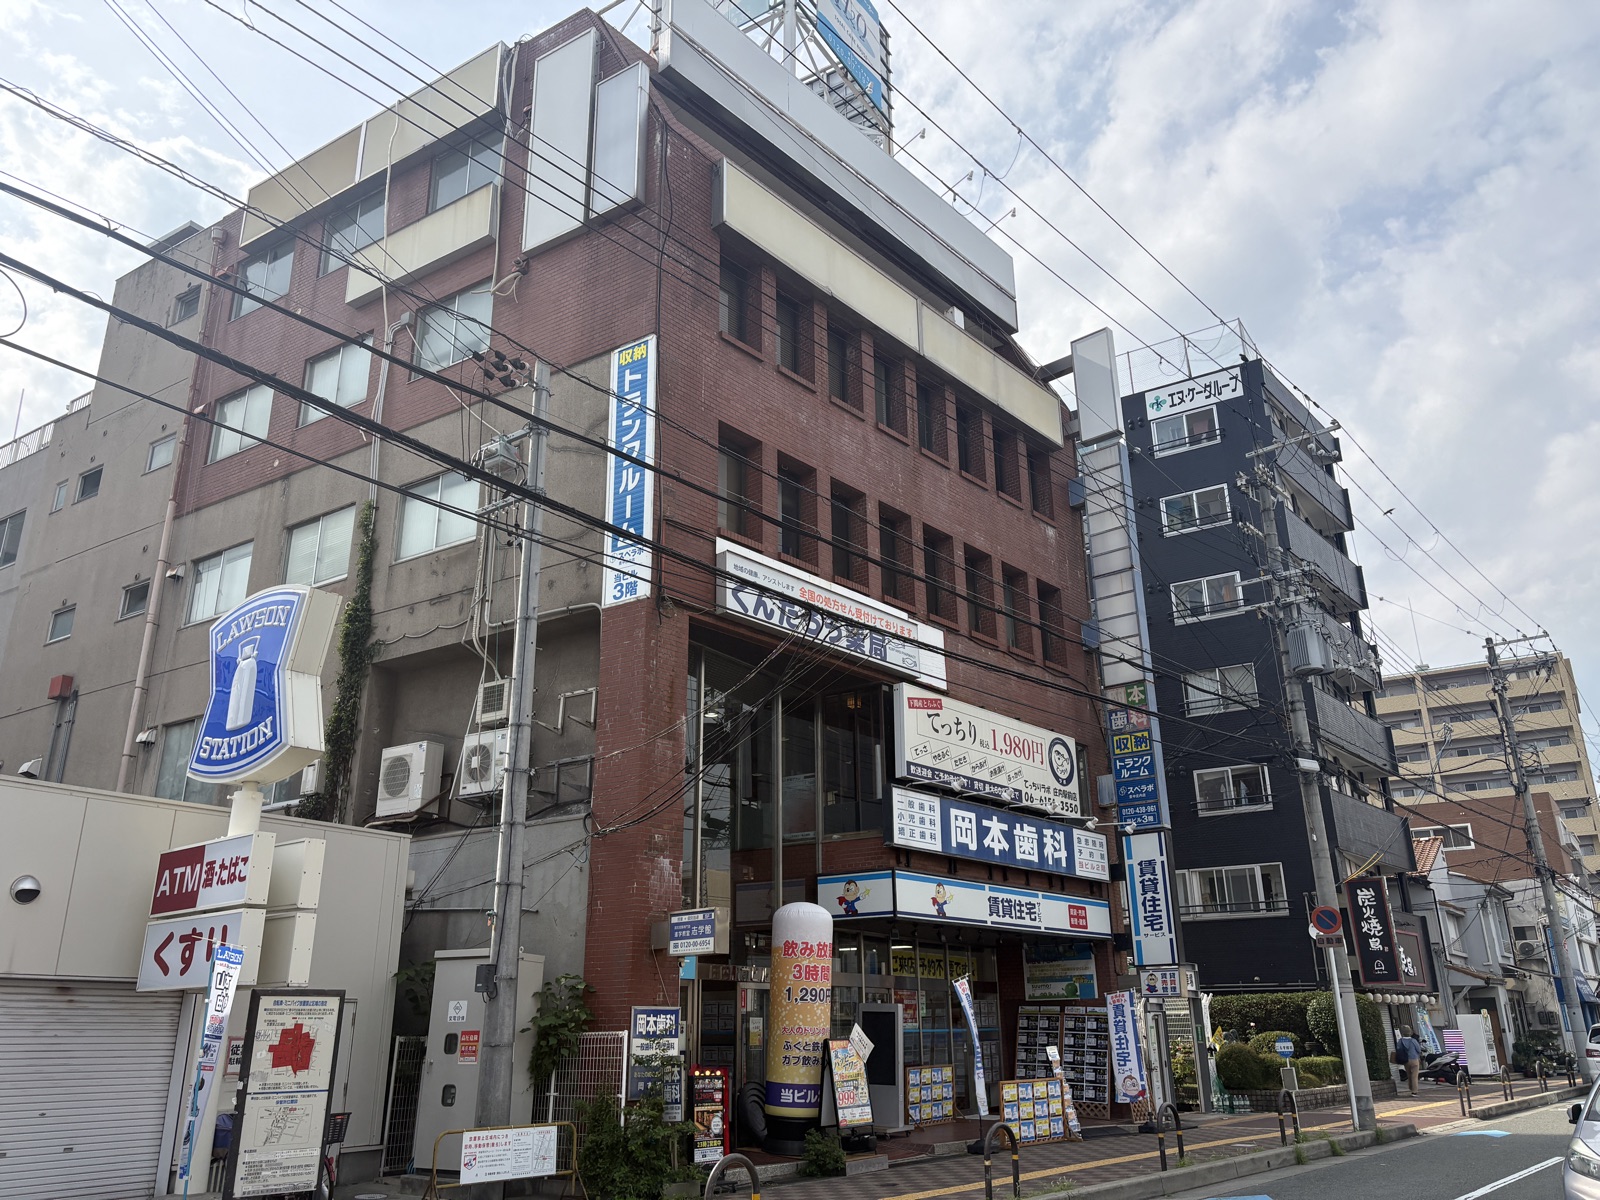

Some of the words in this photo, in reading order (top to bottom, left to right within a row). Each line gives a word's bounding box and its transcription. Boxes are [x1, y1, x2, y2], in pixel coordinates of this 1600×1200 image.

[619, 343, 647, 366] 収納
[612, 580, 638, 601] 3階
[216, 605, 291, 653] LAWSON
[199, 716, 274, 761] STATION
[926, 711, 977, 746] てっちり
[979, 738, 990, 750] 税込
[991, 728, 1044, 766] 1,980円
[1115, 735, 1149, 752] 収納
[1116, 755, 1151, 769] トランク
[1121, 767, 1149, 778] ルーム
[973, 780, 984, 791] 貸切
[1053, 787, 1077, 802] 庄内駅前店
[897, 799, 936, 814] 一般歯科
[897, 812, 937, 828] 小児歯科
[949, 807, 1068, 868] 岡本歯科
[156, 863, 201, 898] ATM
[201, 855, 249, 889] 酒・たばこ
[1137, 858, 1164, 932] 賃貸住宅
[987, 895, 1037, 922] 賃貸住宅
[154, 924, 228, 977] くすり
[792, 963, 831, 983] 3時間
[636, 1014, 676, 1035] 岡本歯科
[663, 1084, 680, 1103] 歯科
[780, 1088, 820, 1104] 当ビル
